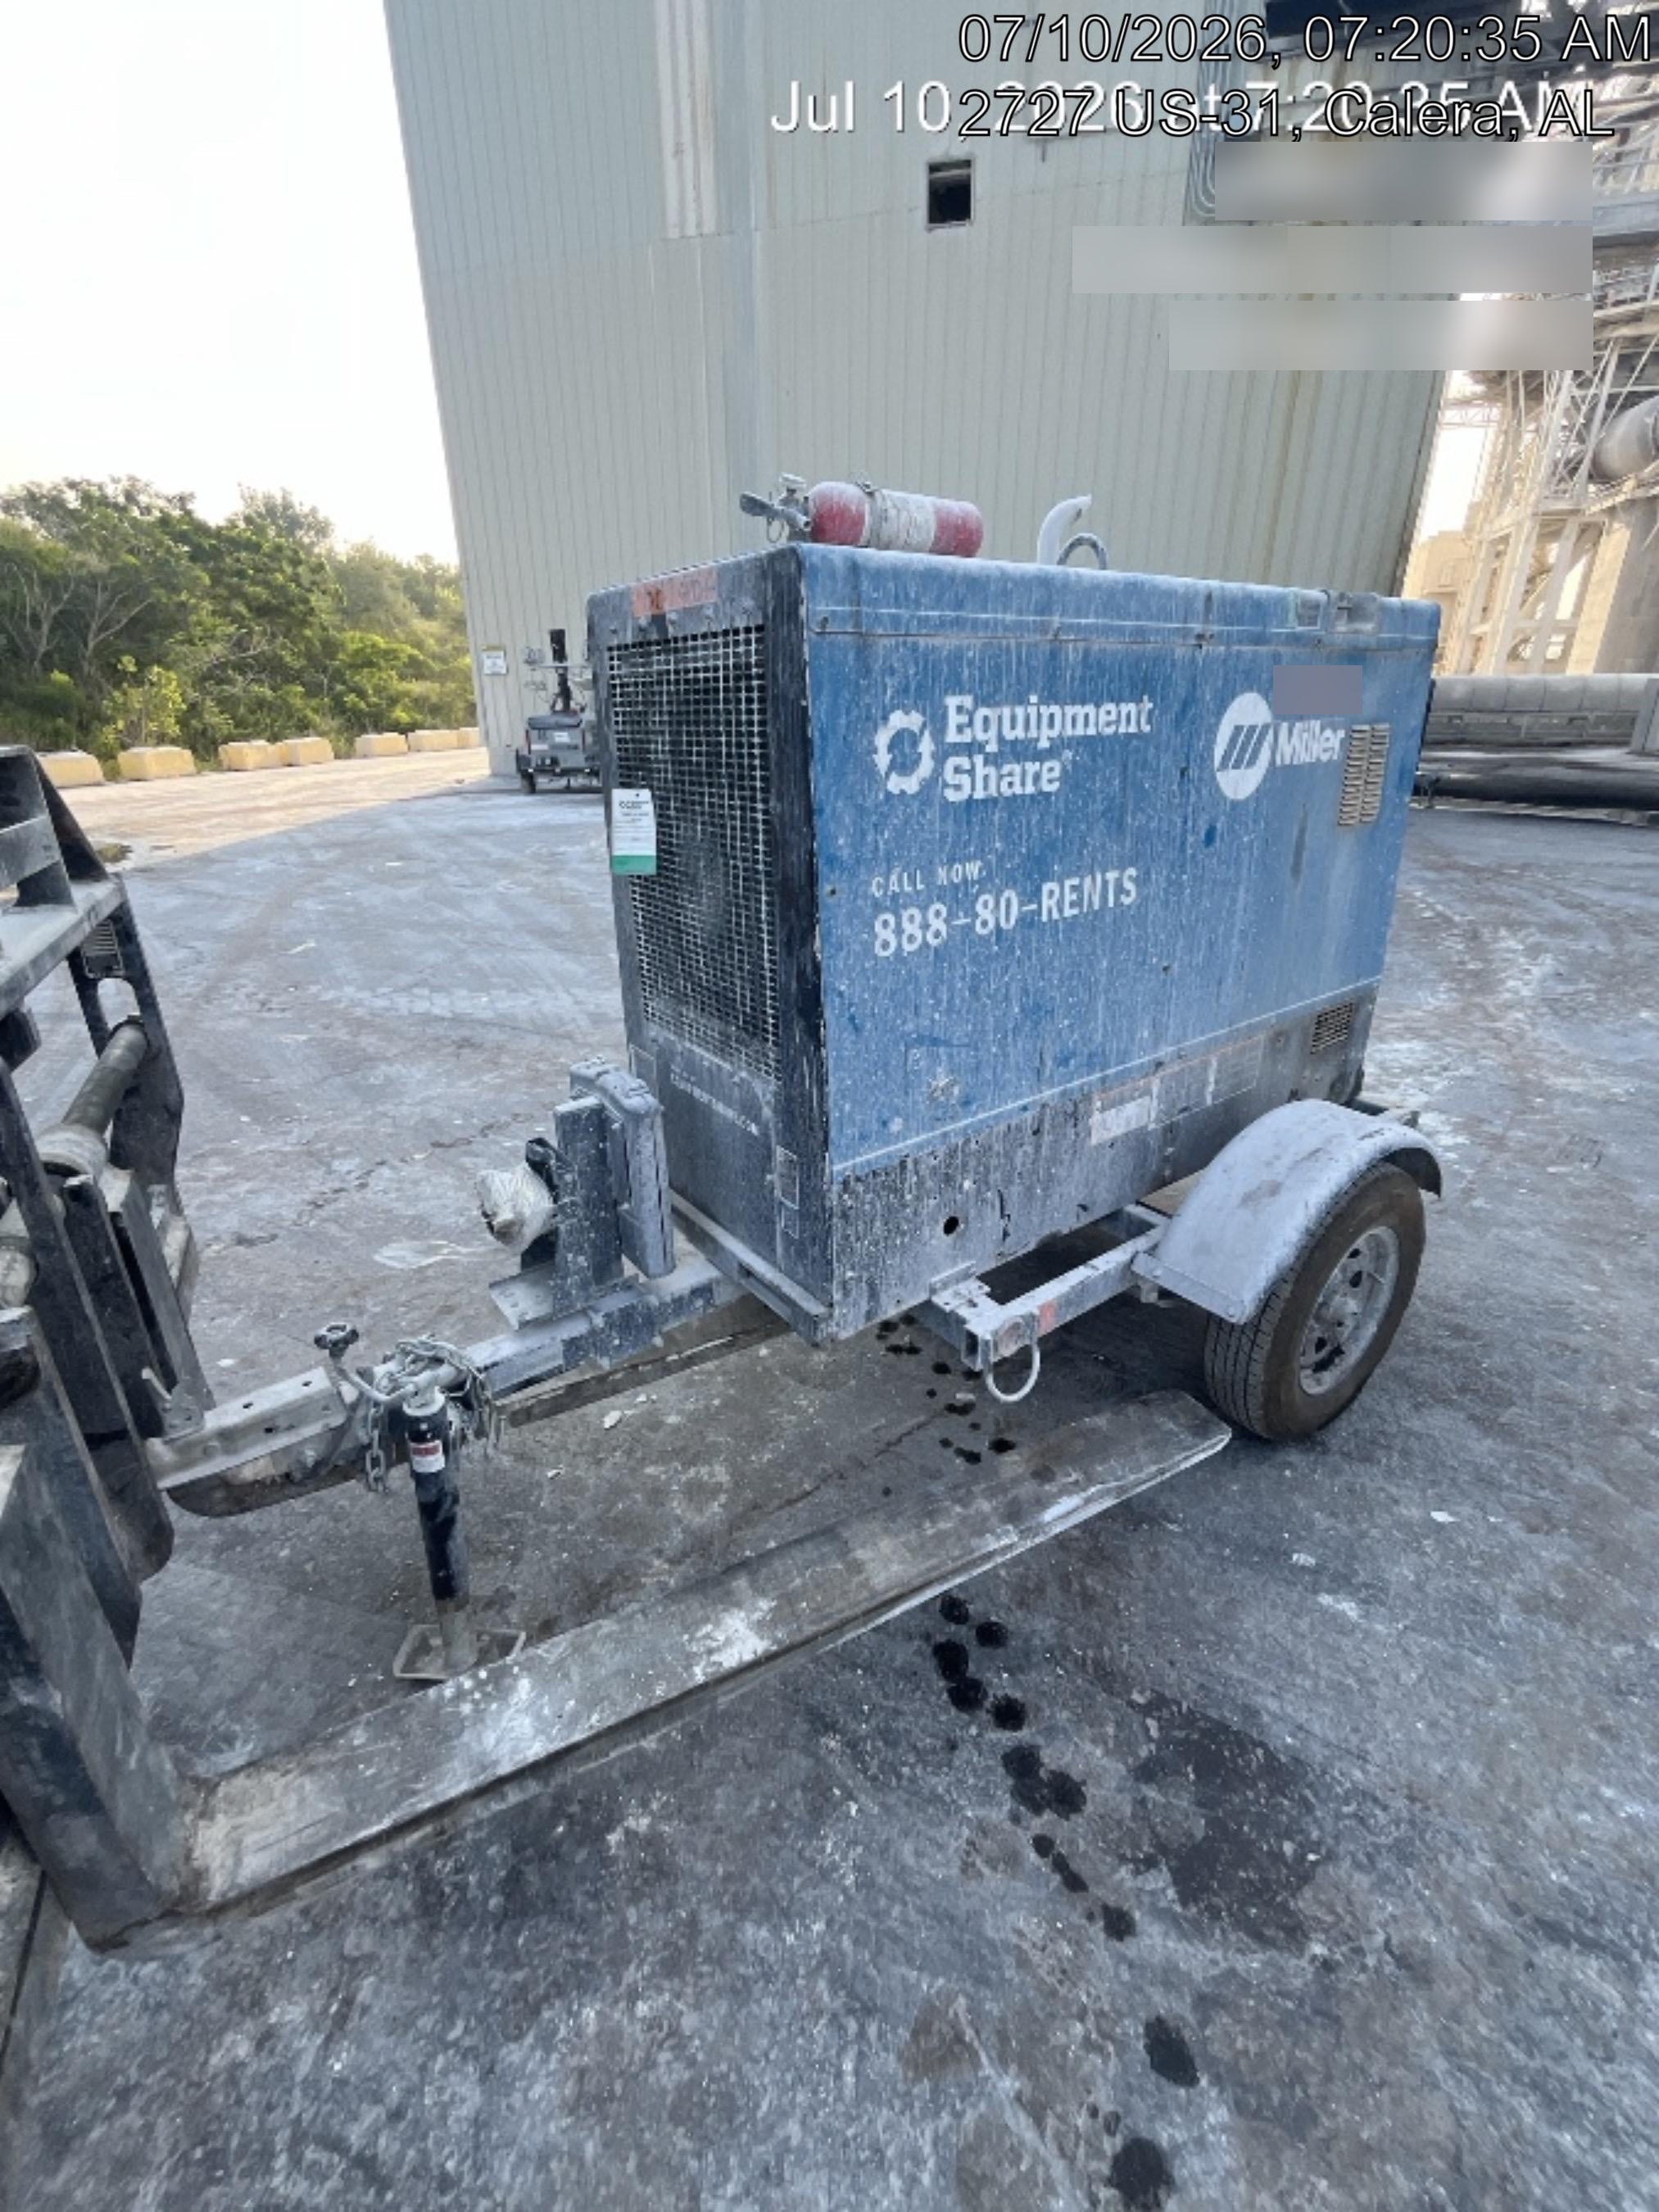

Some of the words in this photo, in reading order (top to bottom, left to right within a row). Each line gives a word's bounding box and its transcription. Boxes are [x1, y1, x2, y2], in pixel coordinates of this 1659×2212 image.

[944, 694, 1154, 753] Equipment
[1275, 718, 1346, 767] Miller
[942, 753, 1063, 802] Share
[872, 868, 925, 898] CALL
[936, 859, 982, 886] NOW
[873, 867, 1138, 958] 888-80-RENTS
